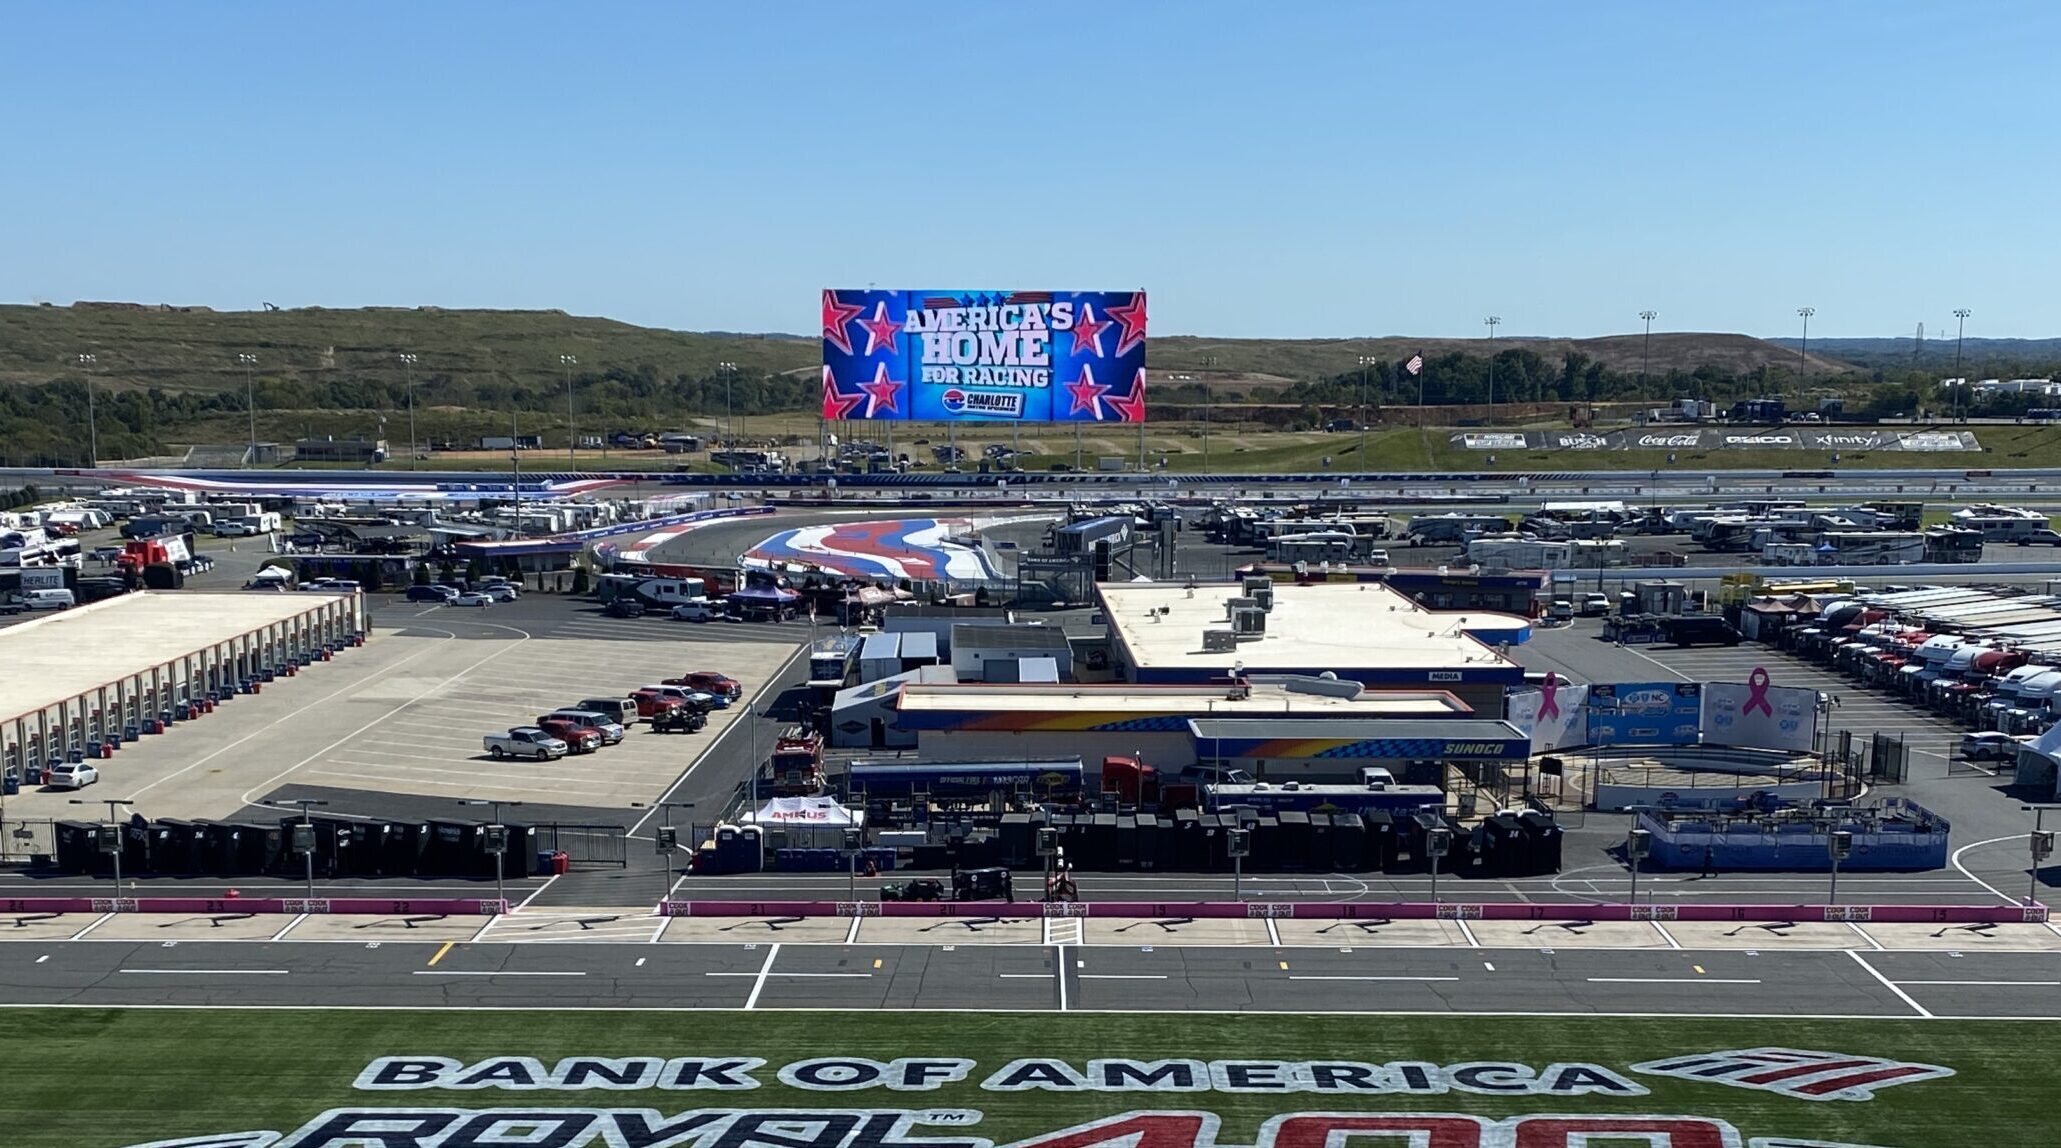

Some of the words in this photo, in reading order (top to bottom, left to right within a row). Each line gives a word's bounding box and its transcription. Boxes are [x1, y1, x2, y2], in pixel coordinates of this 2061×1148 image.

[903, 302, 1073, 333] AMERICA'S
[921, 330, 1049, 366] HOME
[921, 366, 959, 384] FOR
[963, 369, 1048, 387] RACING
[967, 394, 1018, 407] CHARLOTTE
[1559, 437, 1607, 446] BUSCH
[1726, 436, 1792, 444] GEICO
[1816, 434, 1873, 445] xfinity
[22, 576, 59, 585] HERLITE
[1432, 673, 1461, 681] MEDIA
[1651, 693, 1664, 702] NC
[1443, 743, 1504, 755] SUNOCO
[365, 1059, 757, 1087] BANK
[787, 1060, 967, 1087] OF
[991, 1061, 1640, 1093] AMERICA
